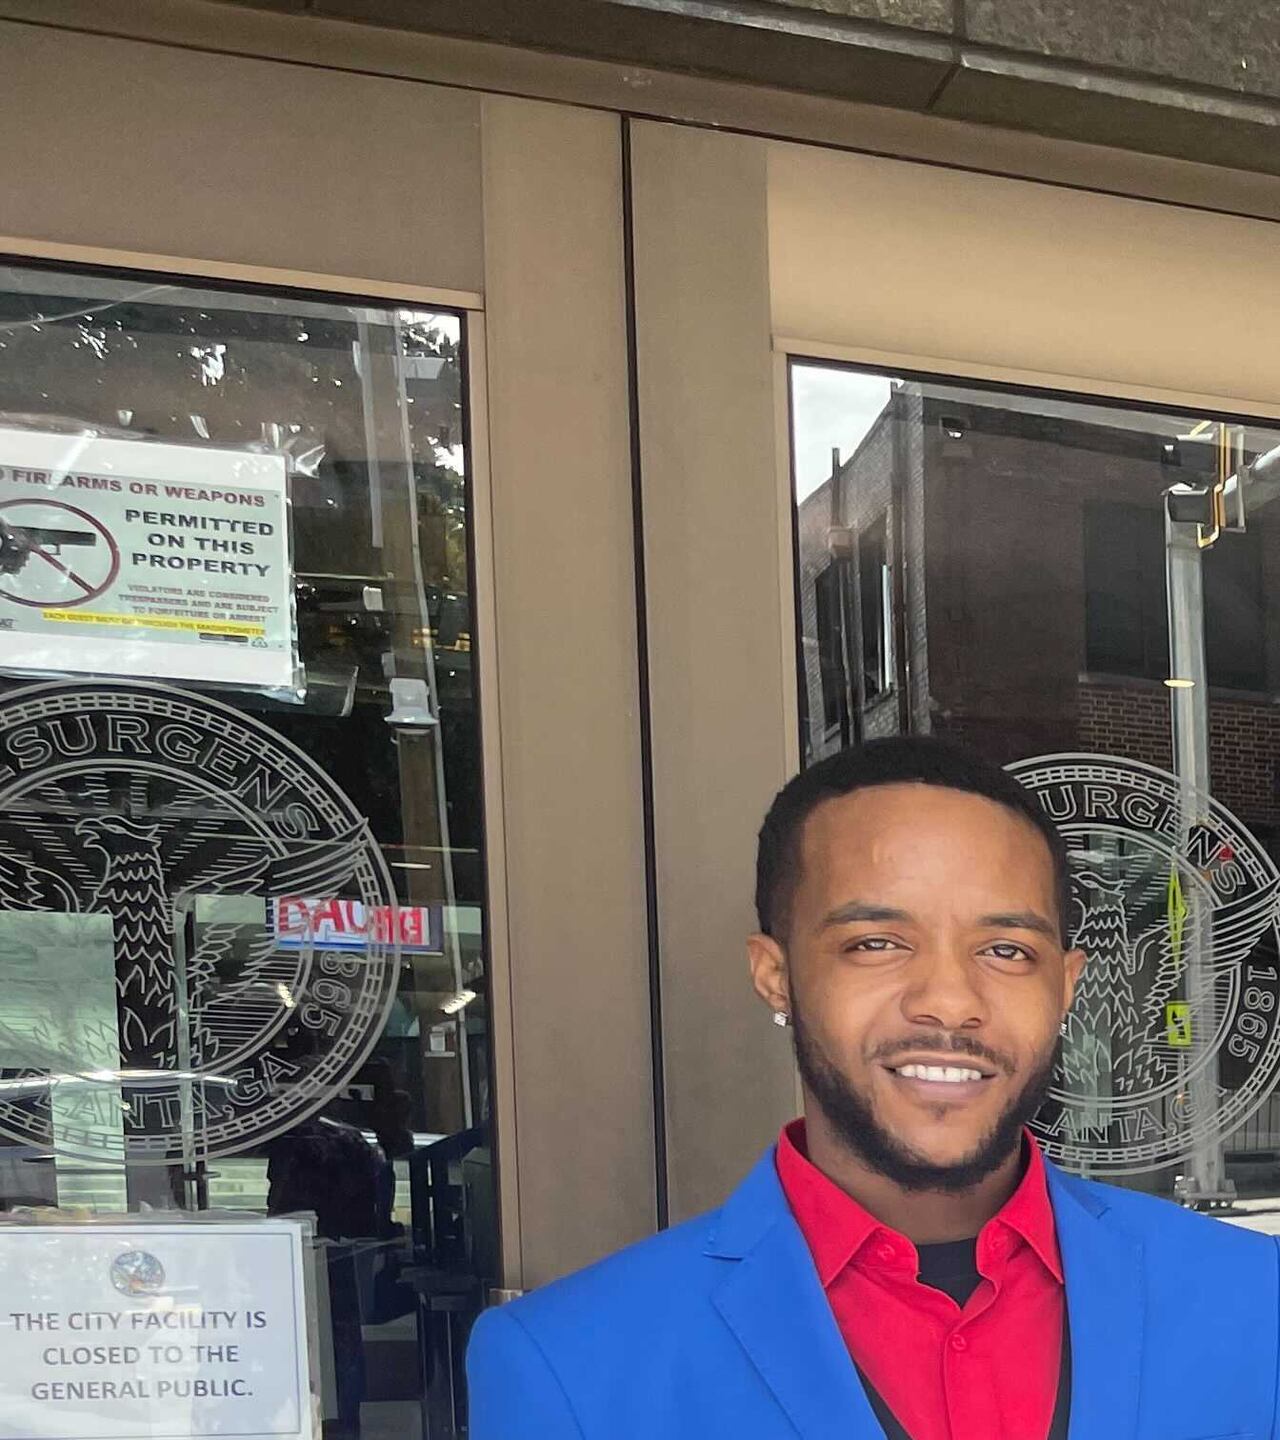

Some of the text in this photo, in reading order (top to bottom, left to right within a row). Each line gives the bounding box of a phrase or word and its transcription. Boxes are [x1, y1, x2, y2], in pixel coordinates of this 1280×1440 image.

[13, 470, 122, 492] FIRARMS
[129, 482, 158, 496] OR
[165, 486, 265, 507] WEAPONS
[125, 509, 274, 536] PERMITTED
[148, 533, 254, 555] ON THIS
[132, 553, 271, 577] PROPERTY
[0, 714, 320, 840] SURGENS
[1038, 785, 1245, 896] URGENS
[1228, 964, 1277, 1063] 1865
[1024, 1105, 1177, 1144] LANTA,
[10, 1311, 266, 1331] THE CITY FACILITY IS
[43, 1346, 239, 1365] CLOSED TO THE
[32, 1379, 253, 1400] GENERAL PUBLIC.
